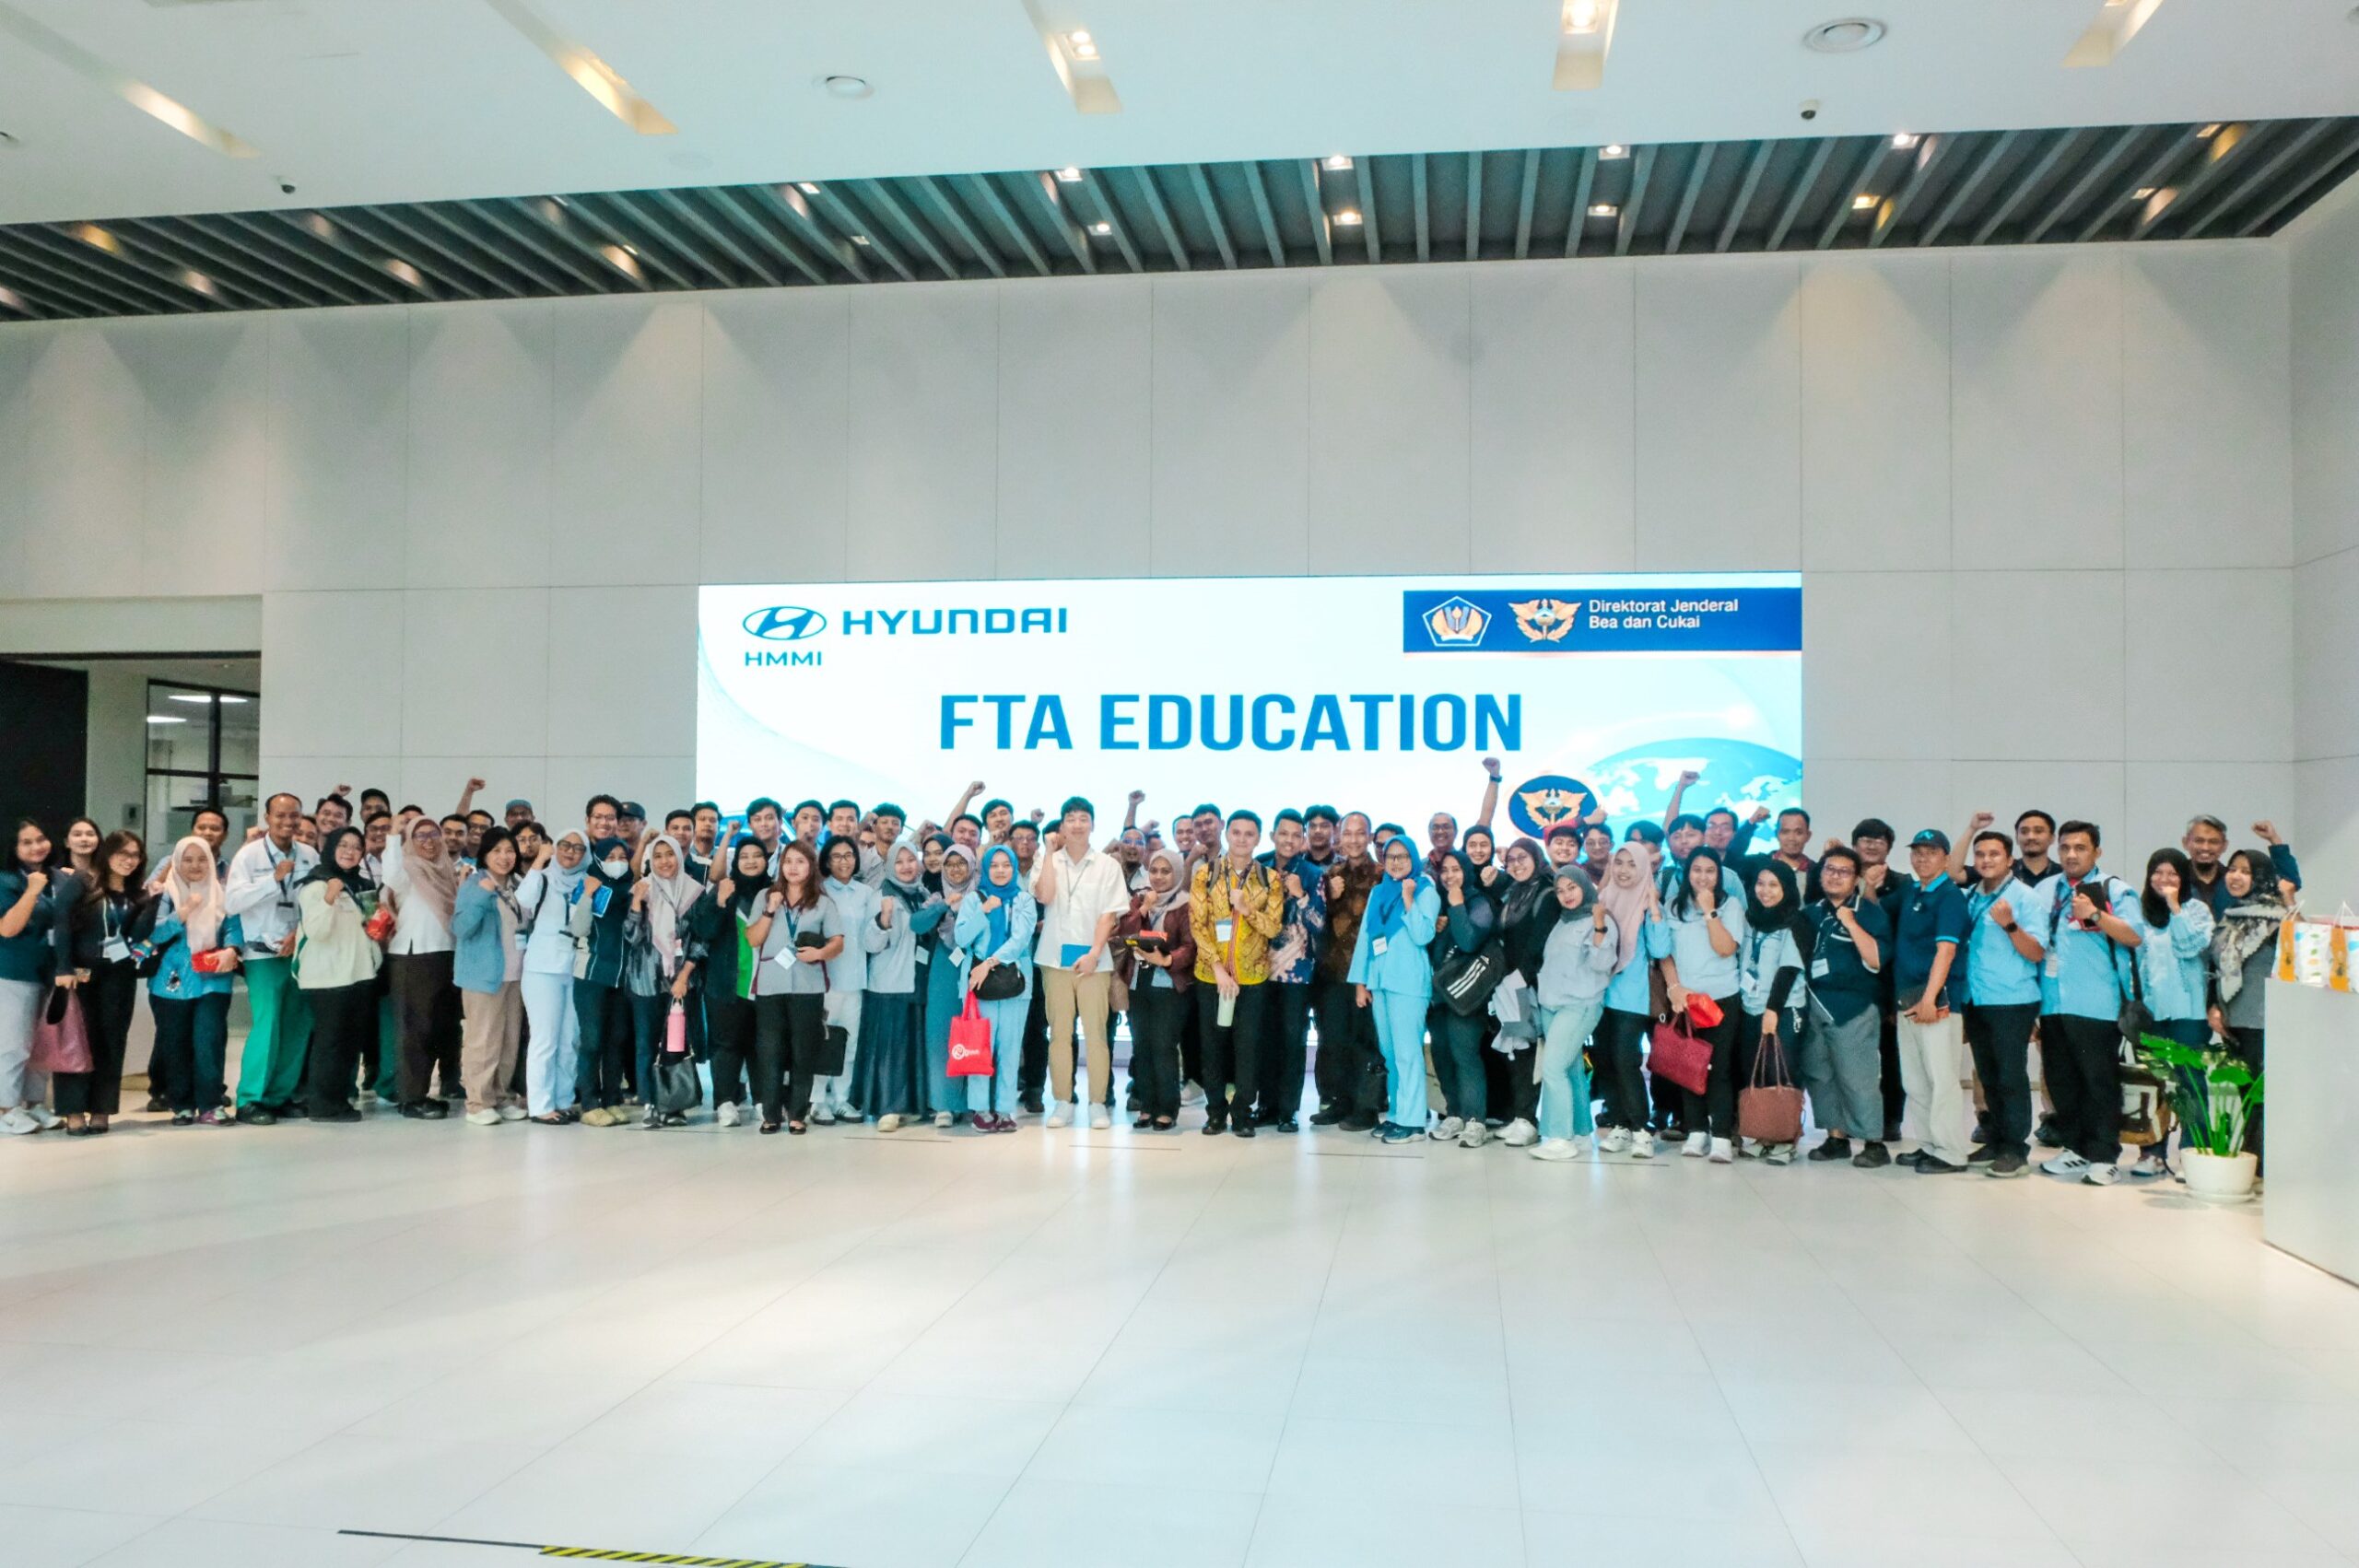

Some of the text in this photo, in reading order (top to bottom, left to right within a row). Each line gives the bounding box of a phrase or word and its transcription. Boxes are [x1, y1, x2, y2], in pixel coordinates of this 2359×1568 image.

[1589, 599, 1739, 613] Direktorat Jenderal
[842, 607, 1068, 636] HYUNDAI
[1589, 614, 1700, 629] Bea dan Cukai
[745, 650, 822, 667] HMMI
[940, 693, 1522, 753] FTA EDUCATION
